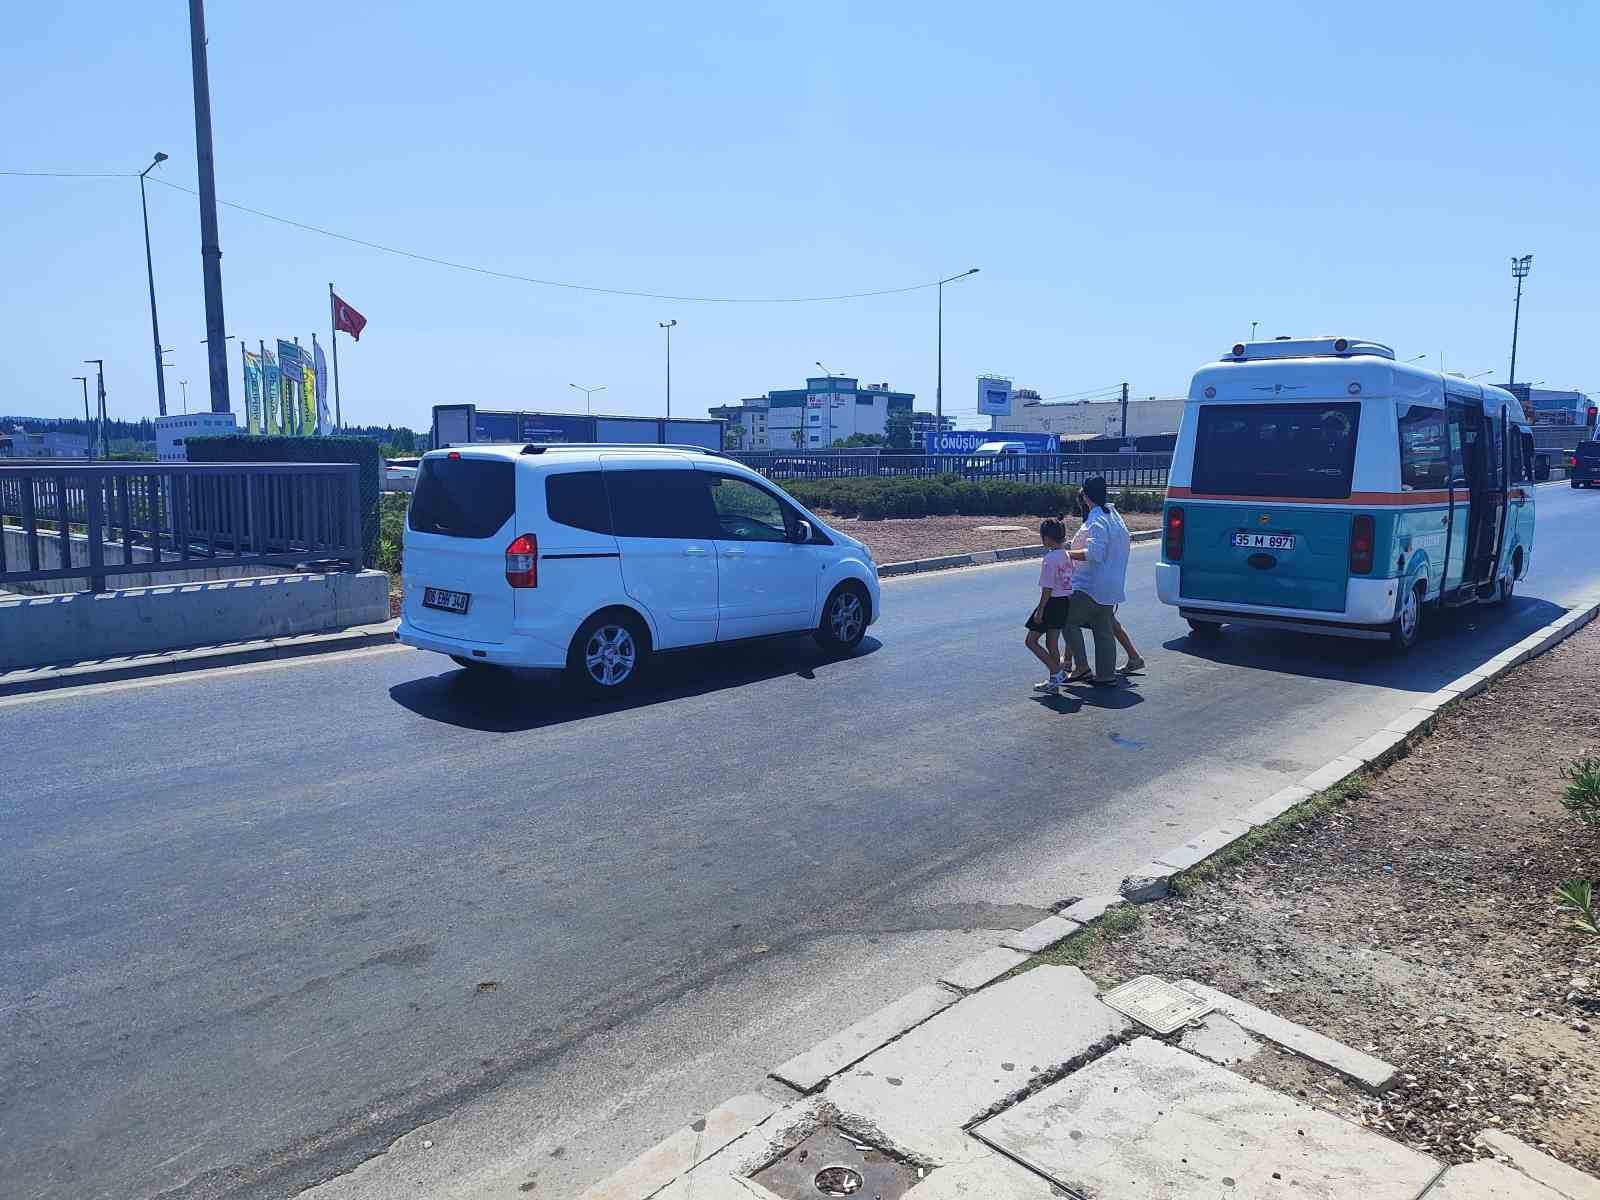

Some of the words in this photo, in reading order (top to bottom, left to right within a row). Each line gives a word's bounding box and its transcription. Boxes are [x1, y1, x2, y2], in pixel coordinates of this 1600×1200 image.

[934, 434, 989, 451] ÖNÜŞÜM
[1236, 534, 1249, 545] 35
[1255, 535, 1264, 547] M
